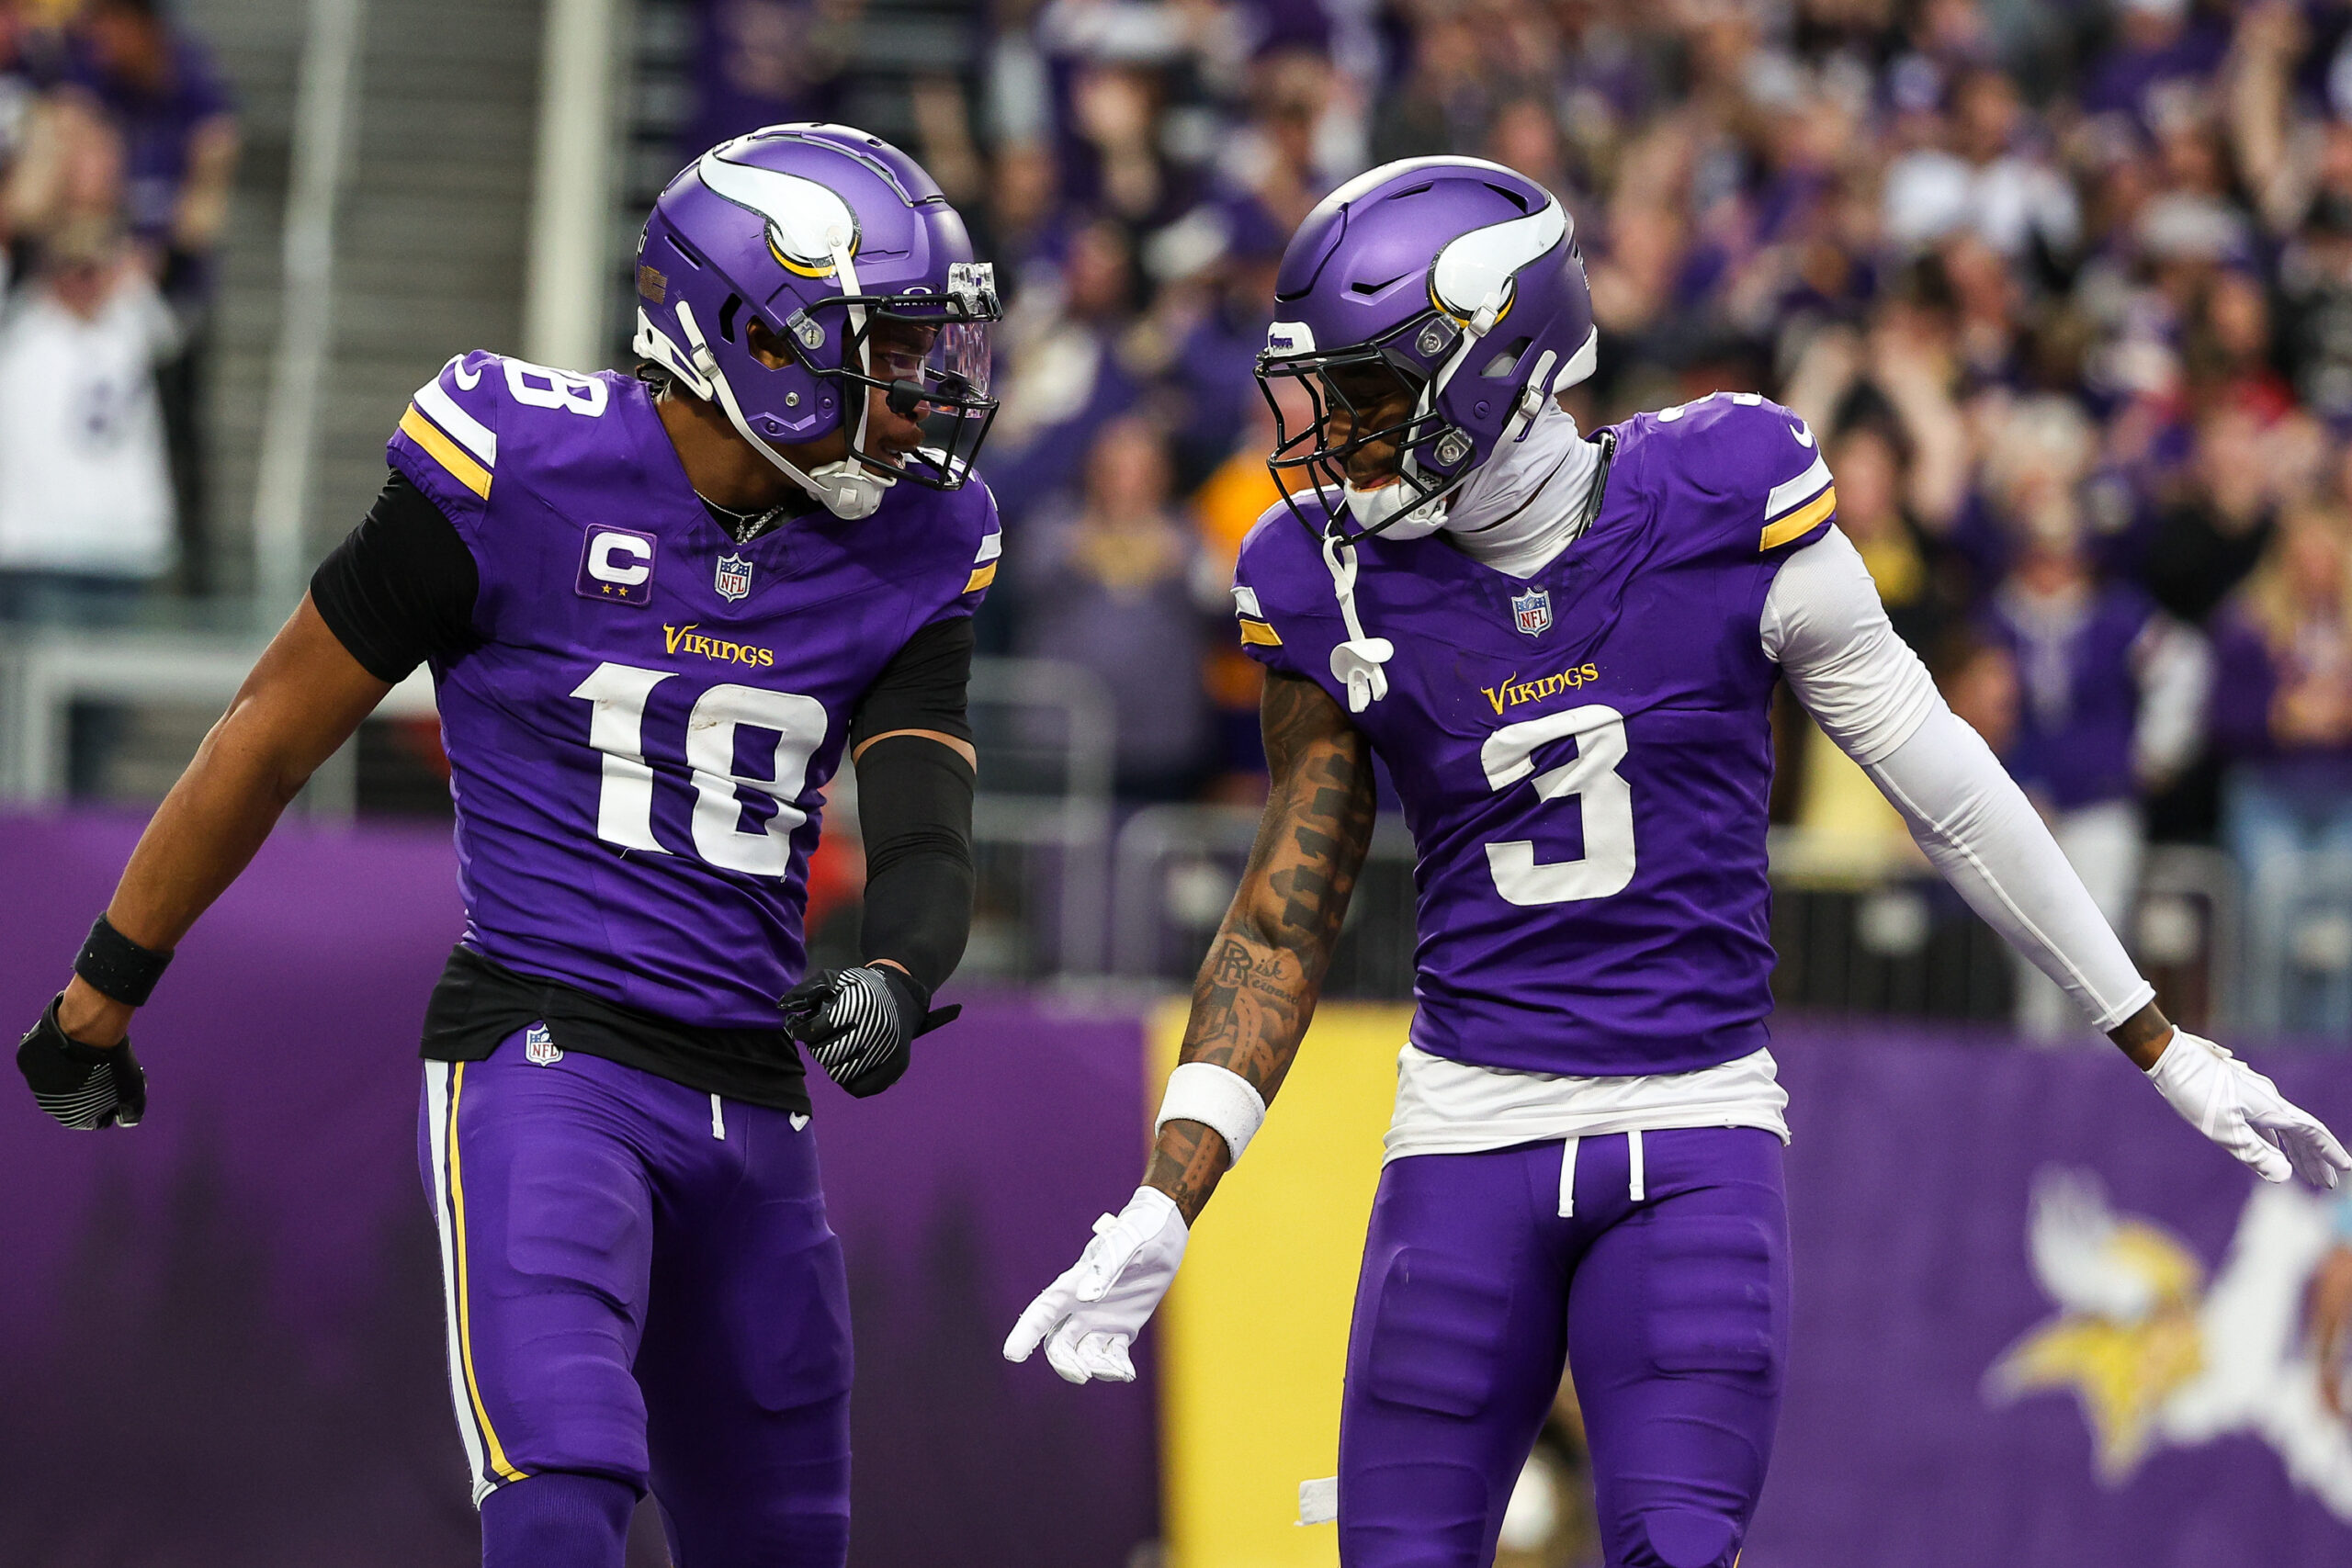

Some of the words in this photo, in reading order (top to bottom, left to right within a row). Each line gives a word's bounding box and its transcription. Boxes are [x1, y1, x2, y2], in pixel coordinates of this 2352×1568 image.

[588, 532, 652, 586] C
[720, 573, 745, 593] NFL
[1521, 610, 1547, 628] NFL
[569, 661, 828, 877] 18
[1480, 704, 1636, 906] 3
[533, 1043, 558, 1059] NFL
